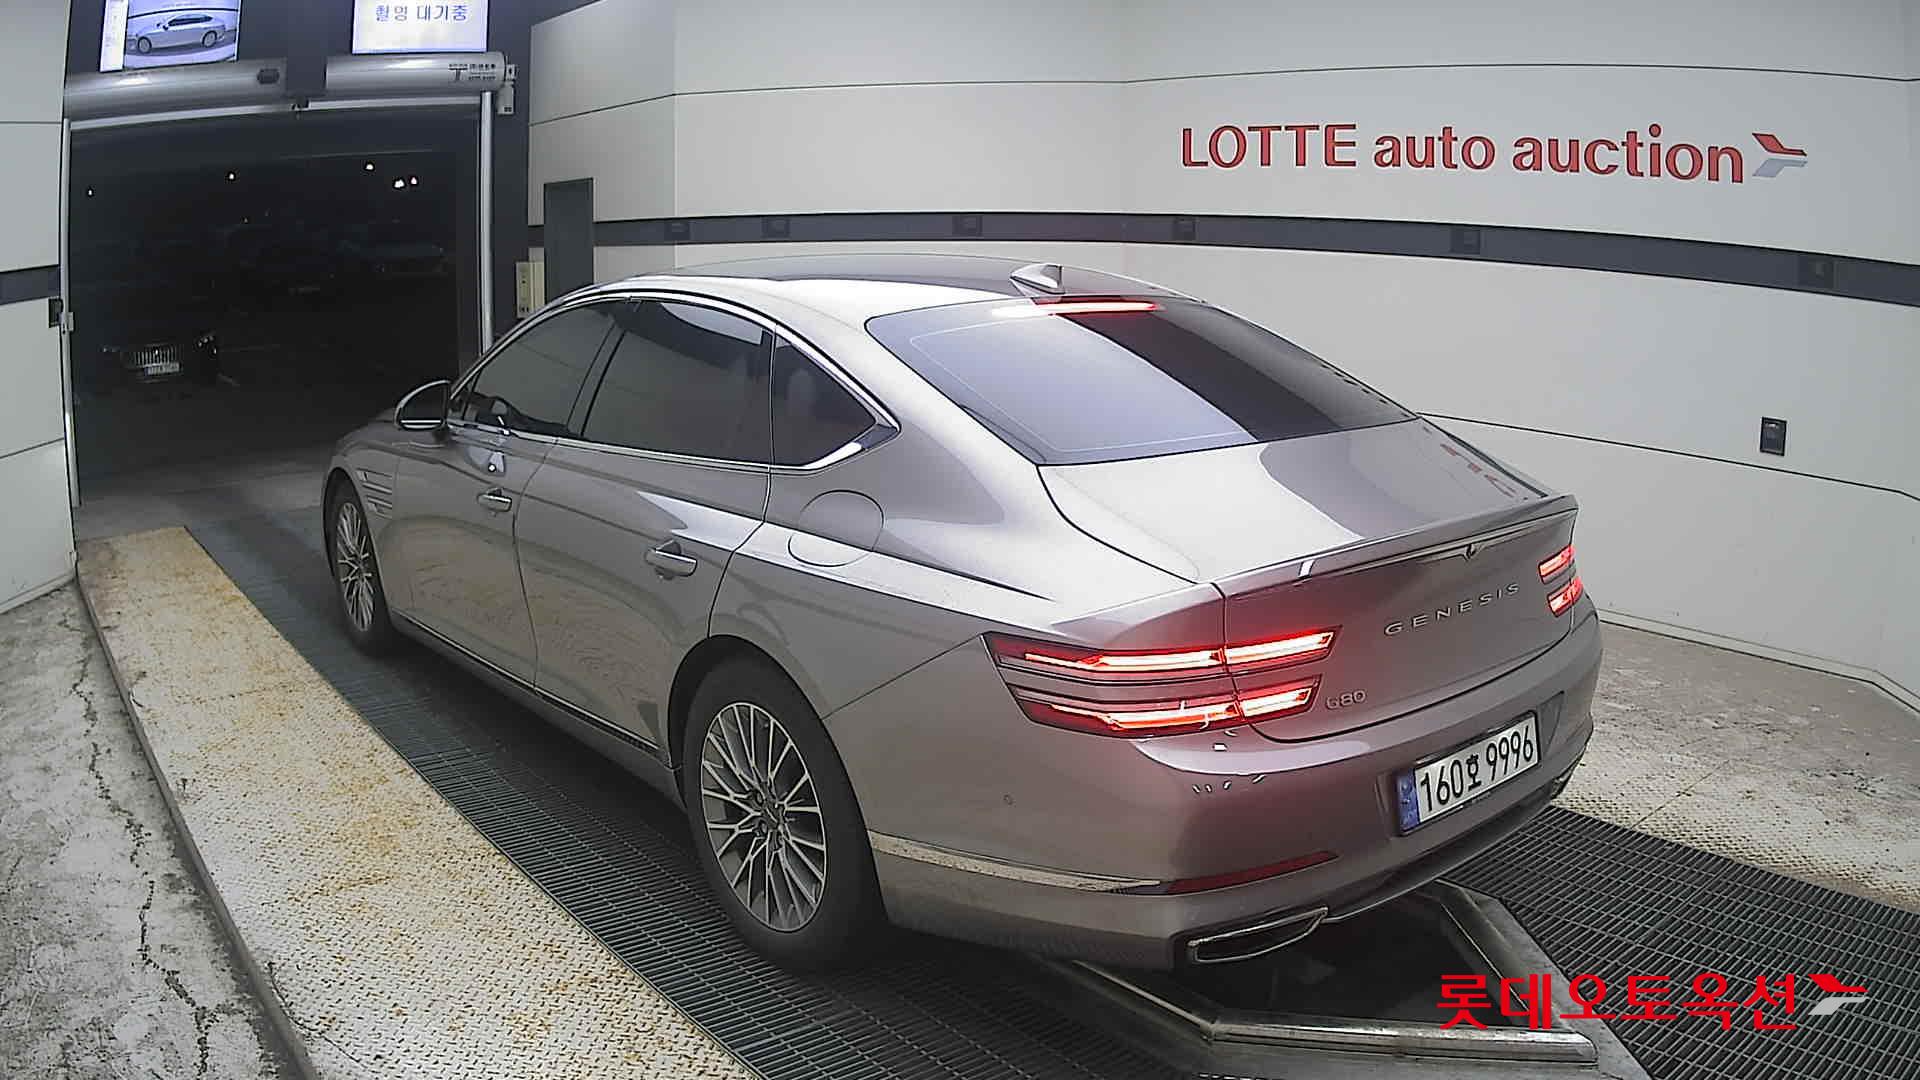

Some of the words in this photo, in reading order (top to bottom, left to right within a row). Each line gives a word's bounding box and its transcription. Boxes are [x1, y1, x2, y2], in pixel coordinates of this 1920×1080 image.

[416, 4, 468, 21] 대기중
[1182, 124, 1357, 168] LOTTE
[1374, 126, 1496, 169] auto
[1512, 124, 1744, 184] auction
[1384, 583, 1519, 636] GENESIS
[1326, 689, 1367, 710] G80
[1486, 725, 1534, 781] 9996
